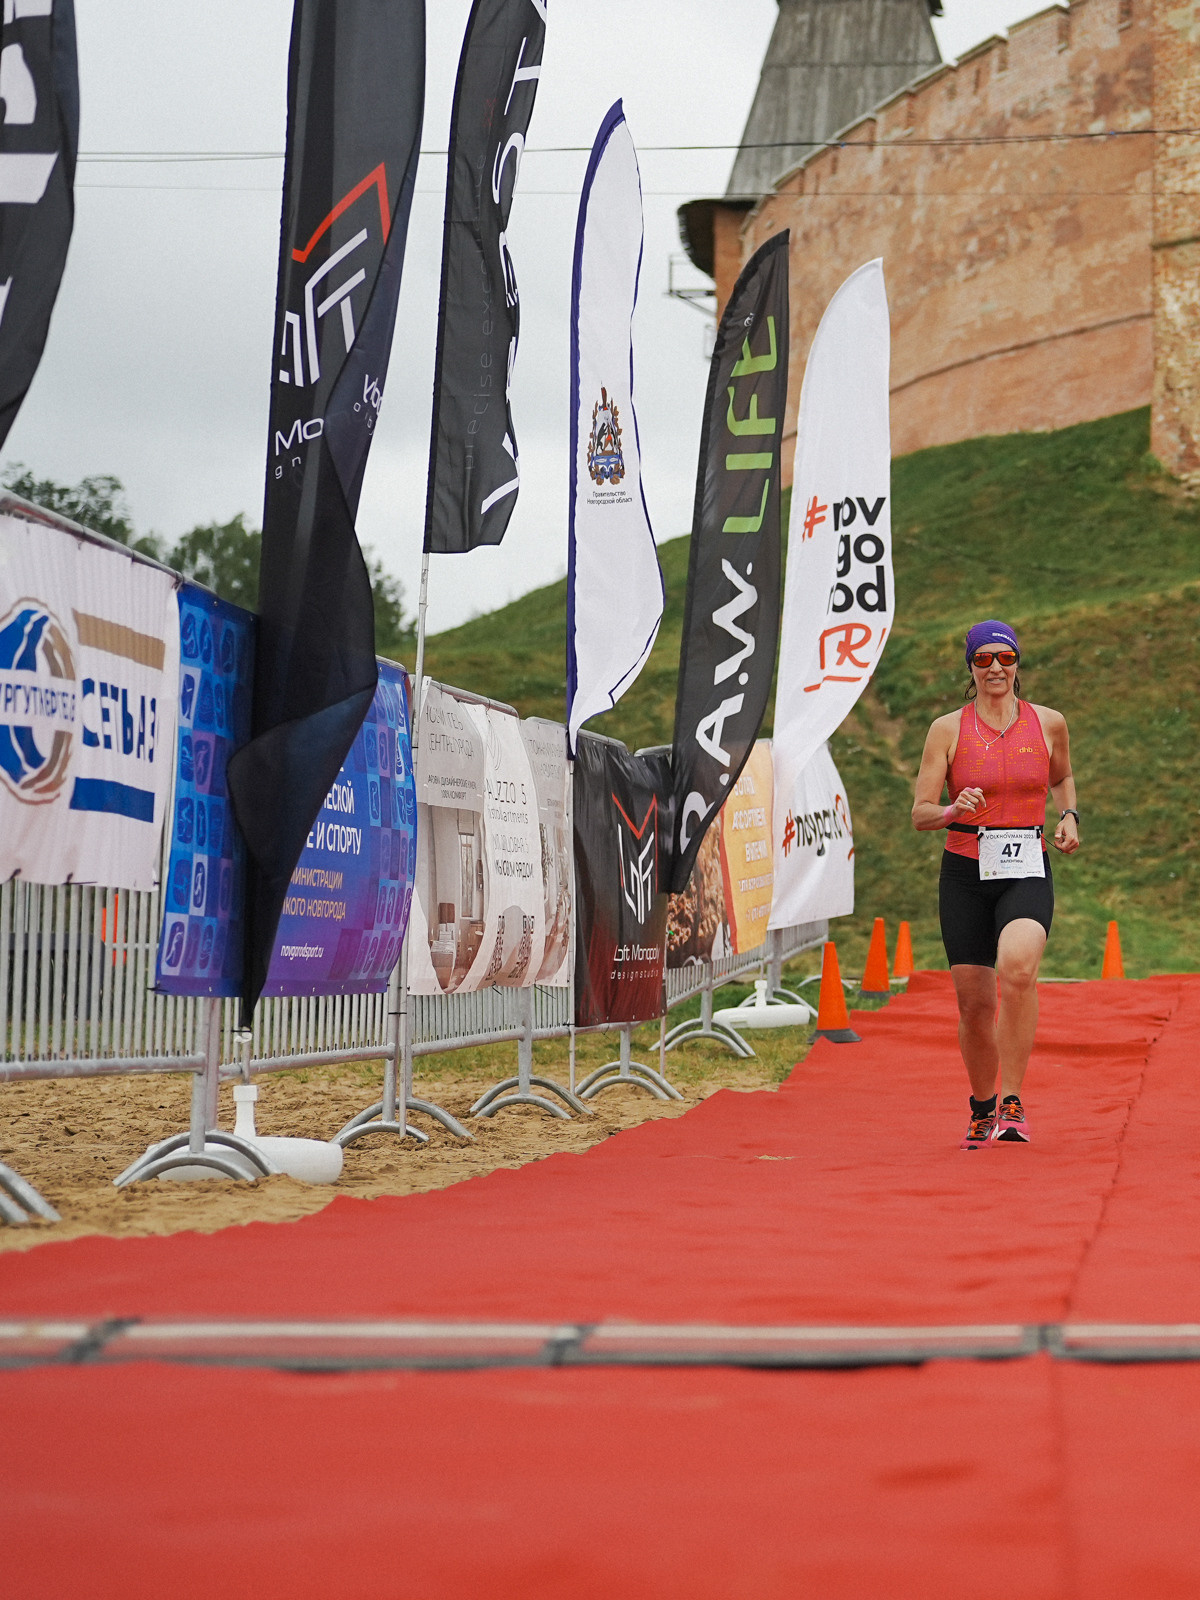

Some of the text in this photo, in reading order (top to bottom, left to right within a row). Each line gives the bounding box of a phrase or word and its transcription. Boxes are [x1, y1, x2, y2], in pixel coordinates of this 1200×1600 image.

[316, 821, 325, 850] И
[326, 823, 362, 856] СПОРТУ
[1001, 842, 1022, 858] 47
[306, 898, 346, 922] НОВГОРОДА
